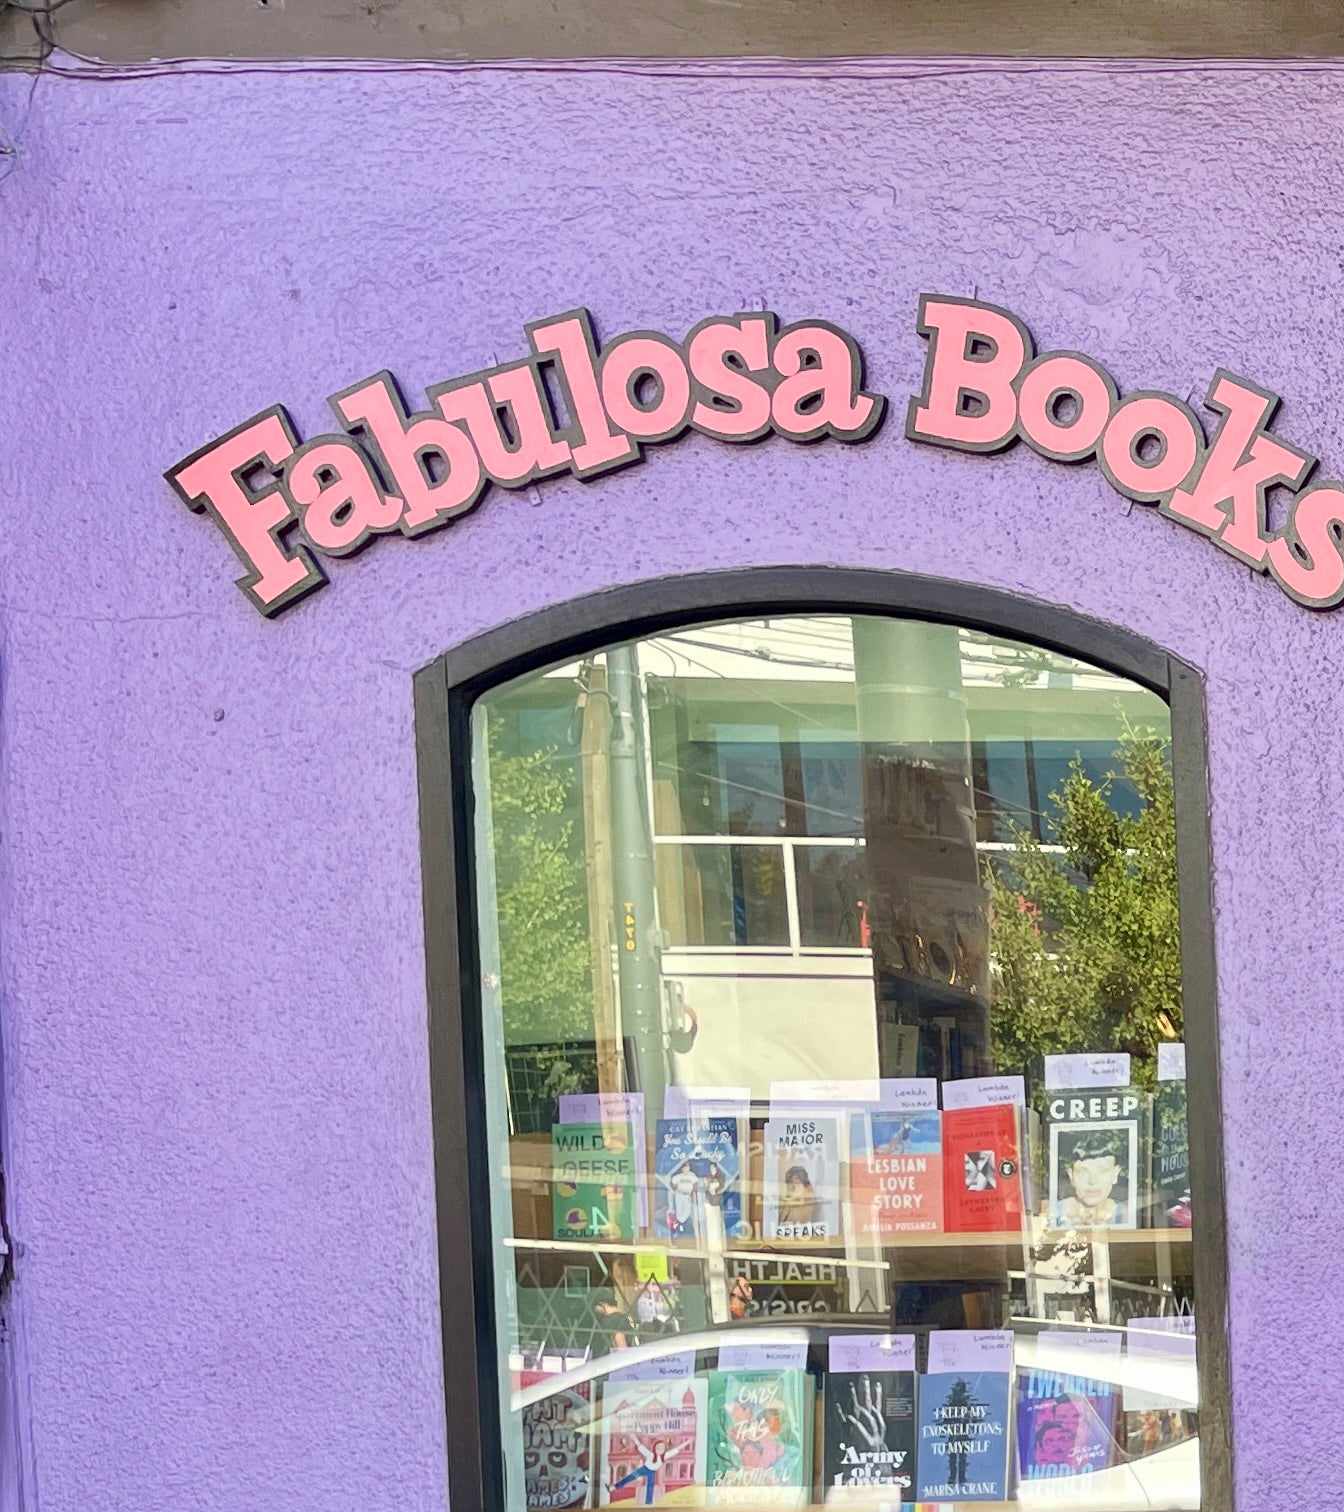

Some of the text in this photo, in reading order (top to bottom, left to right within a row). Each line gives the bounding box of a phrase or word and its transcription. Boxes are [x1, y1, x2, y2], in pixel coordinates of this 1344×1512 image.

[165, 306, 887, 617] Fabulosa
[1050, 1096, 1138, 1119] CREEP
[786, 1122, 816, 1134] MISS
[556, 1135, 605, 1152] WILD
[867, 1158, 927, 1174] LESBIAN
[1161, 1157, 1189, 1173] HOUS
[880, 1176, 915, 1191] LOVE
[874, 1194, 923, 1209] STORY
[896, 1221, 937, 1231] POSSANZA
[739, 1386, 779, 1403] ONLY
[735, 1418, 769, 1440] THIS
[839, 1442, 908, 1468] Army
[931, 1440, 991, 1455] TO MYSELF
[833, 1473, 912, 1488] Lovers
[922, 1481, 998, 1498] MARISA CRANE
